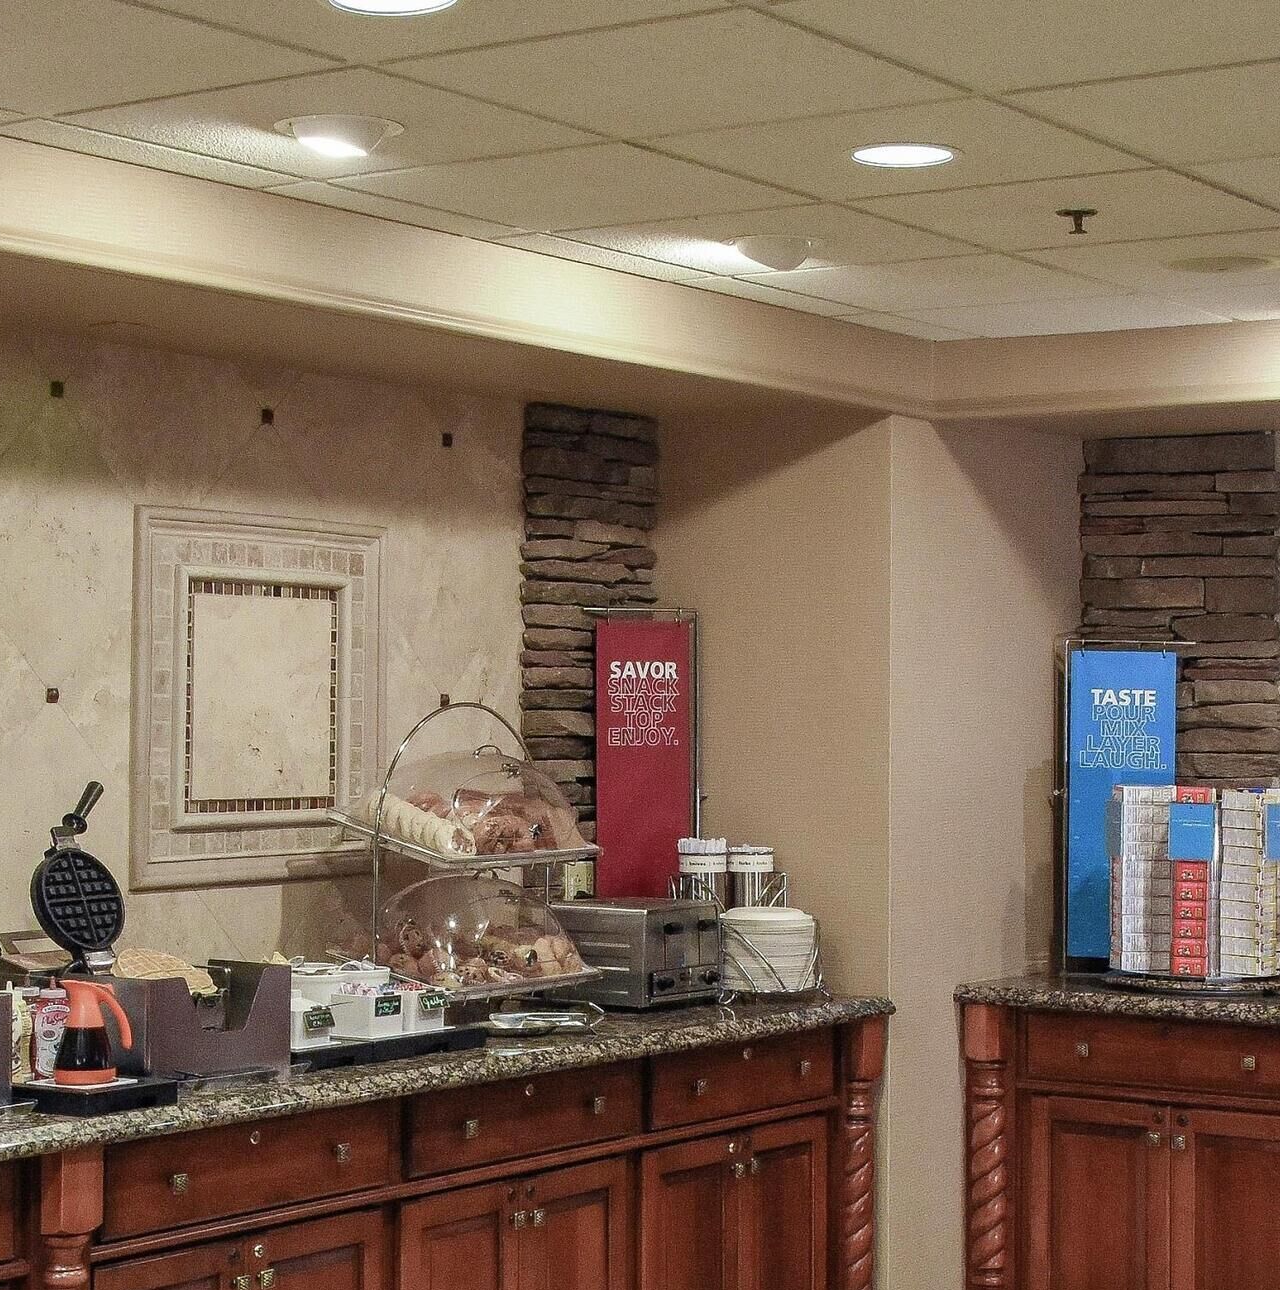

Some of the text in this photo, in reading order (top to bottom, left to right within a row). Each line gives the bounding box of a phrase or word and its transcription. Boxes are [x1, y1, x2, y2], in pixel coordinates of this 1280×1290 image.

[610, 661, 677, 679] SAVOR
[608, 677, 680, 695] SNACK
[611, 694, 677, 712] STACK
[1091, 688, 1157, 706] TASTE
[624, 710, 664, 729] TOP
[1092, 704, 1156, 721] POUR
[608, 727, 679, 746] ENJOY.
[1100, 719, 1147, 737] MIX
[1087, 735, 1161, 753] LAYER
[1080, 750, 1167, 769] LAUGH.
